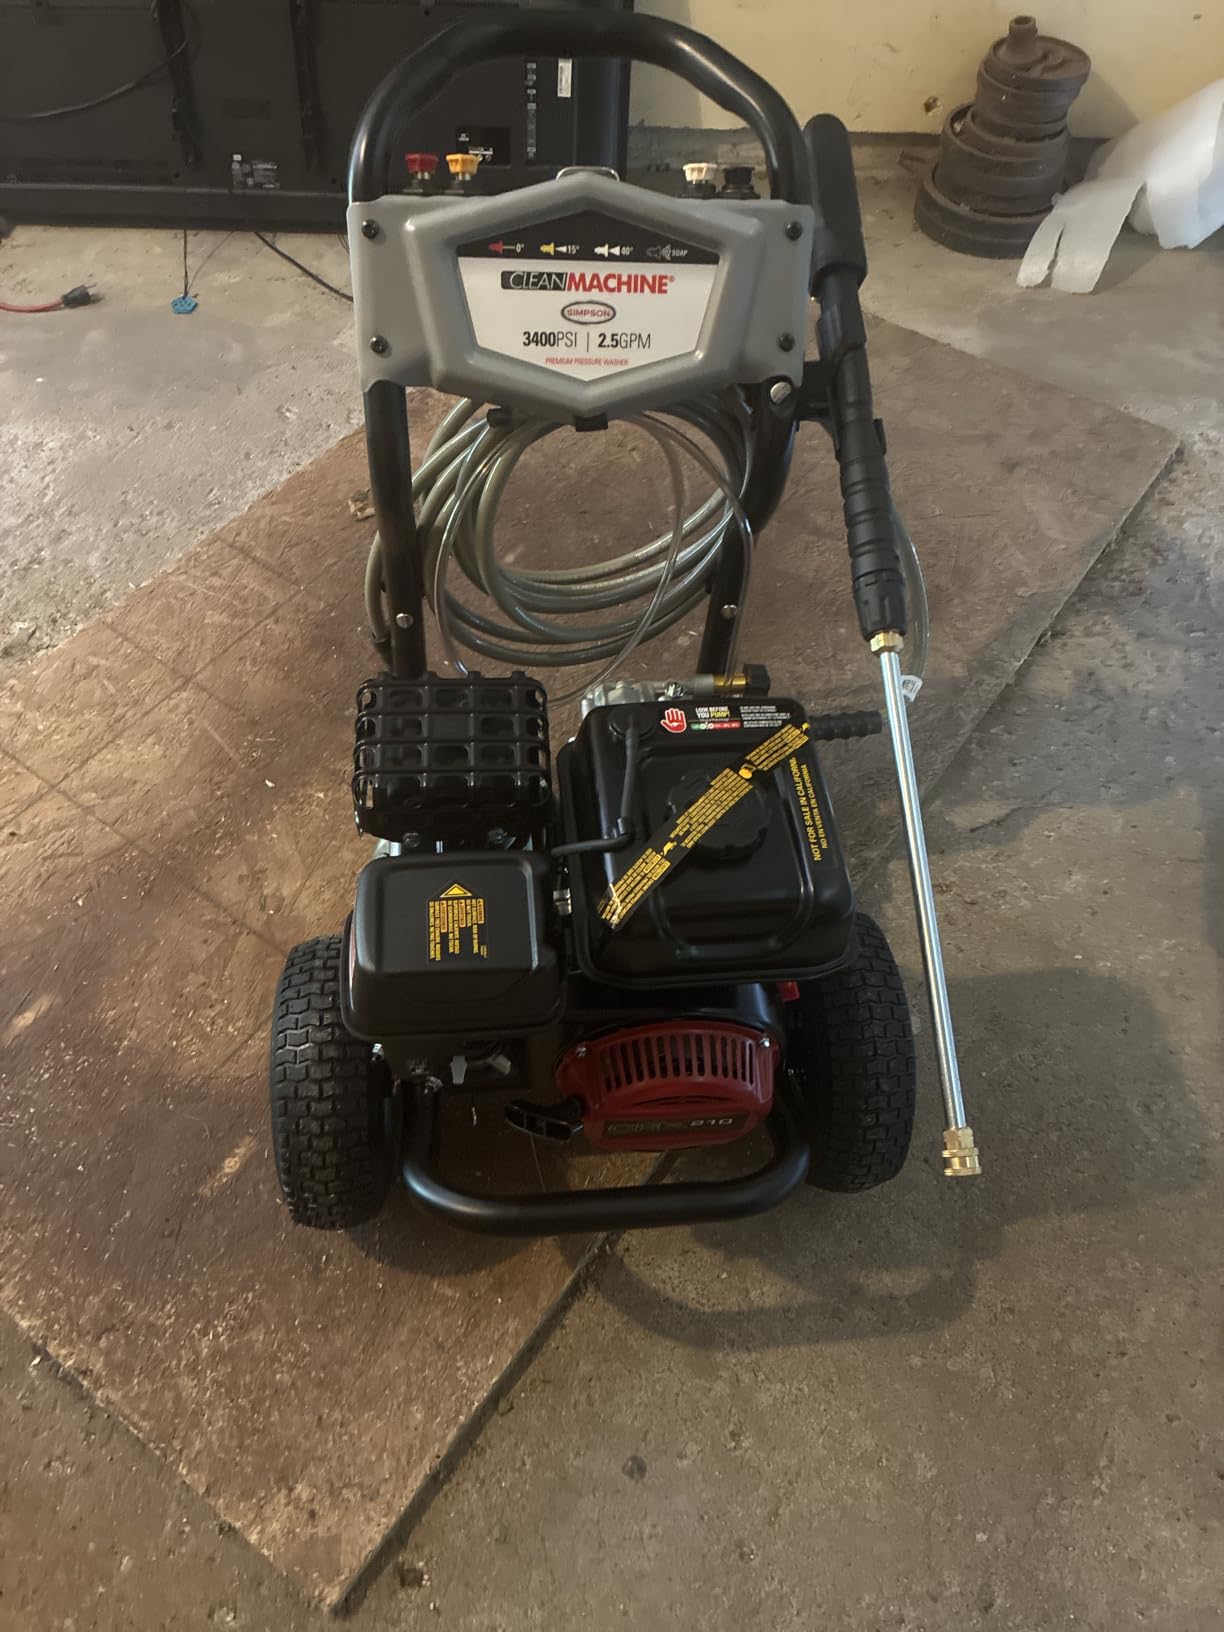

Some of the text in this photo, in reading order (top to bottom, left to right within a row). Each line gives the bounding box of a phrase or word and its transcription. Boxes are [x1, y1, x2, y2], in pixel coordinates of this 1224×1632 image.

[566, 308, 611, 318] SIMPSON
[522, 331, 651, 349] 3400PSI 2.5GPM
[545, 357, 629, 366] PREMIUM PRESSURE WASHER
[799, 797, 808, 806] IN
[800, 764, 828, 849] NO EN VENTA EN CALIFORNIA
[801, 806, 812, 826] SALE
[807, 827, 817, 842] FOR
[810, 843, 822, 861] NOT
